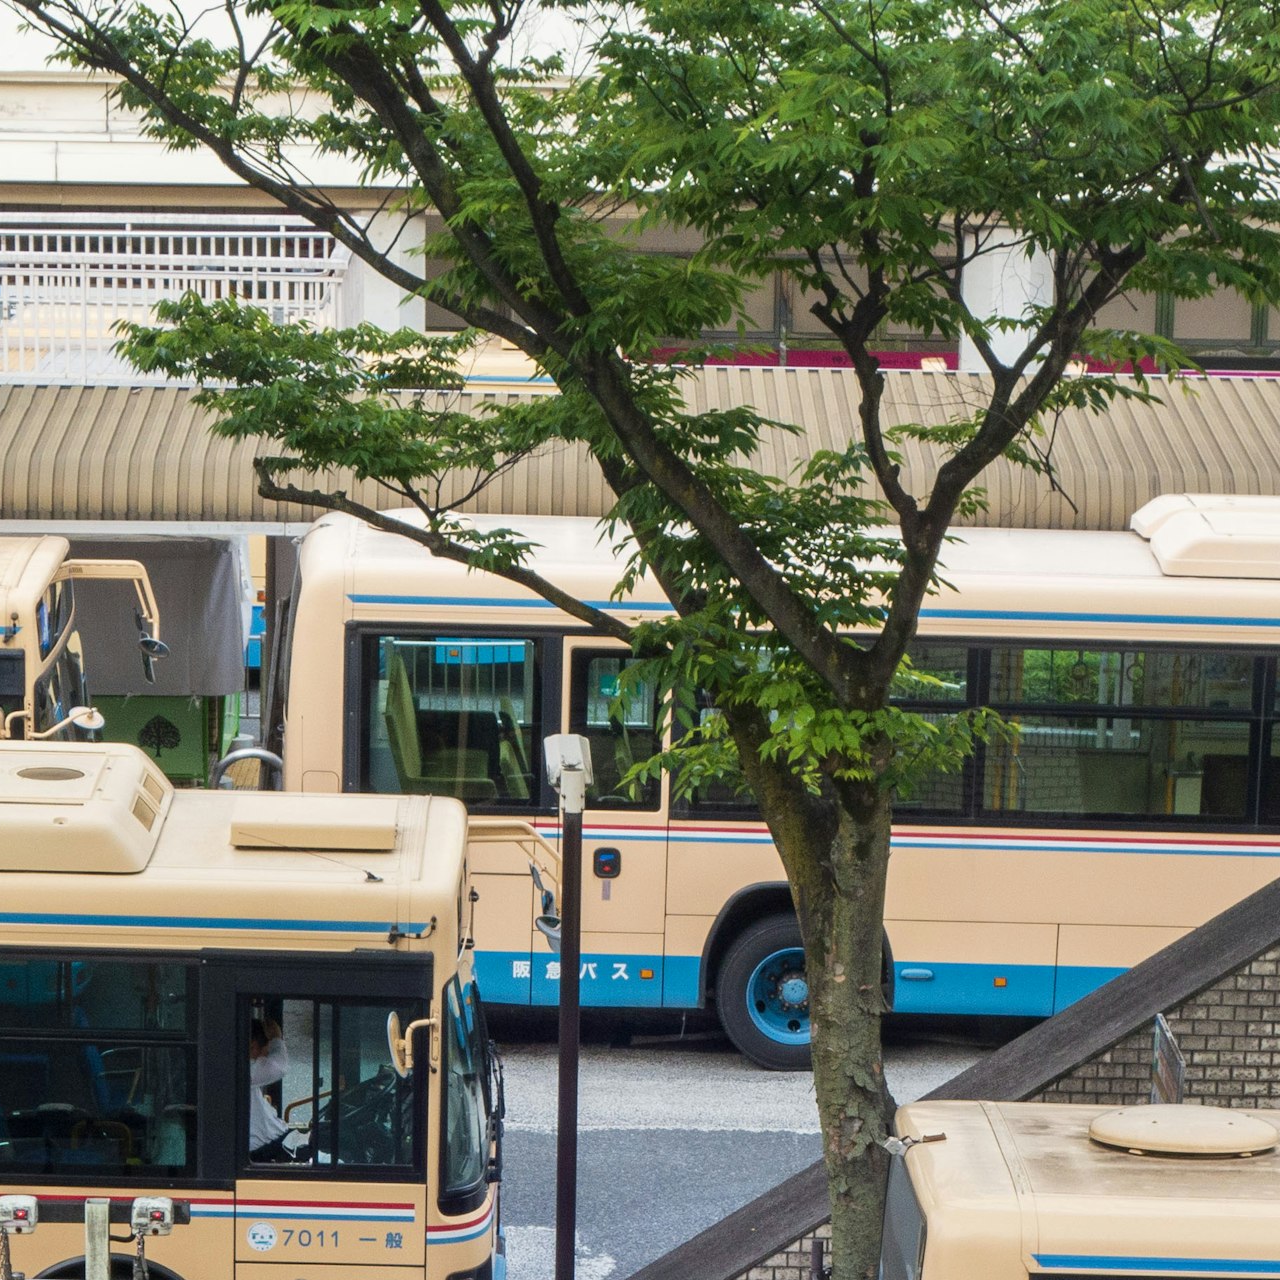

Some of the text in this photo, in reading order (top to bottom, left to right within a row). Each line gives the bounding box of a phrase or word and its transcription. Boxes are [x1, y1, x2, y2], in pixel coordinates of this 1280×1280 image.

[512, 960, 629, 980] 阪急バス
[282, 1229, 339, 1247] 7011
[359, 1232, 403, 1249] 一般
